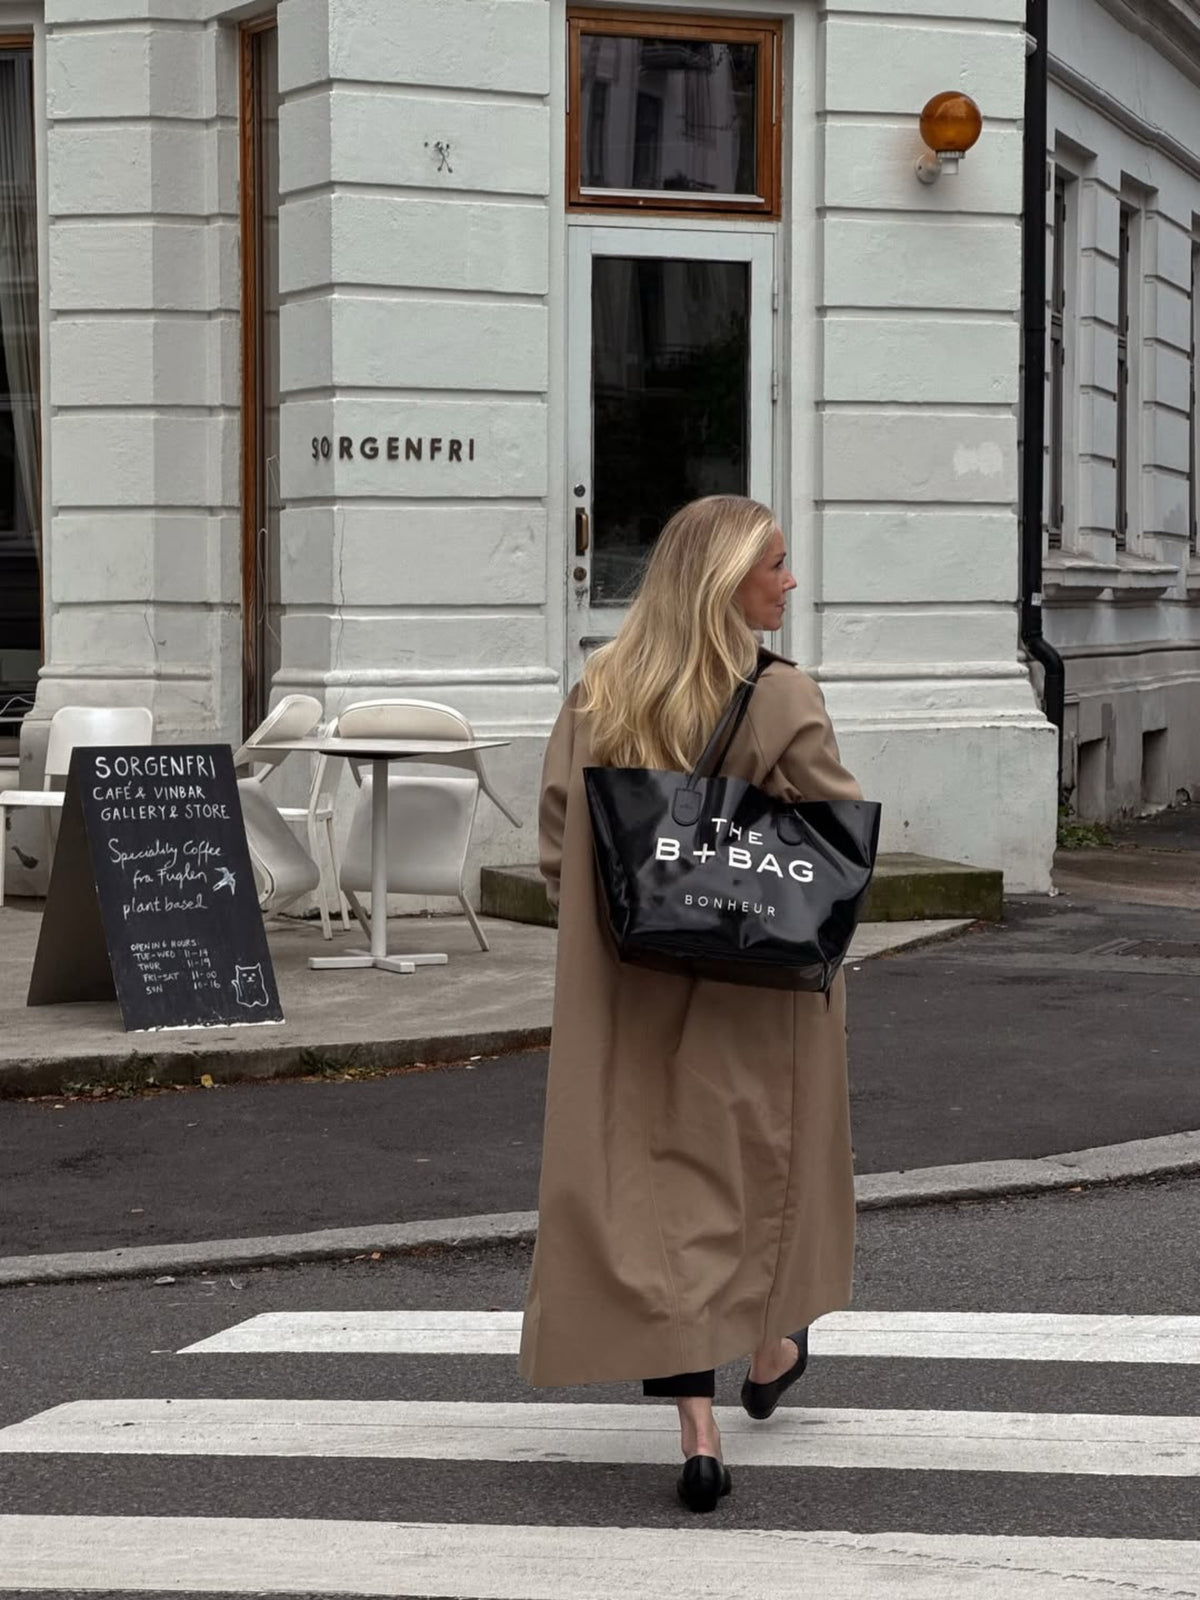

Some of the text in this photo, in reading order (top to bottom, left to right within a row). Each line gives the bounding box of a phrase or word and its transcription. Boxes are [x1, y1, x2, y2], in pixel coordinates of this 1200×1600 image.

[312, 436, 474, 462] SORGENFRI
[95, 755, 216, 779] SORGENFRI
[93, 781, 206, 800] CAFÉ & VINBAR
[101, 804, 230, 820] GALLERY & STORE
[711, 818, 764, 845] THE
[183, 840, 221, 866] Coffee
[133, 862, 207, 889] fra Fuglen
[123, 893, 208, 920] plant based
[685, 895, 776, 916] BONHEUR
